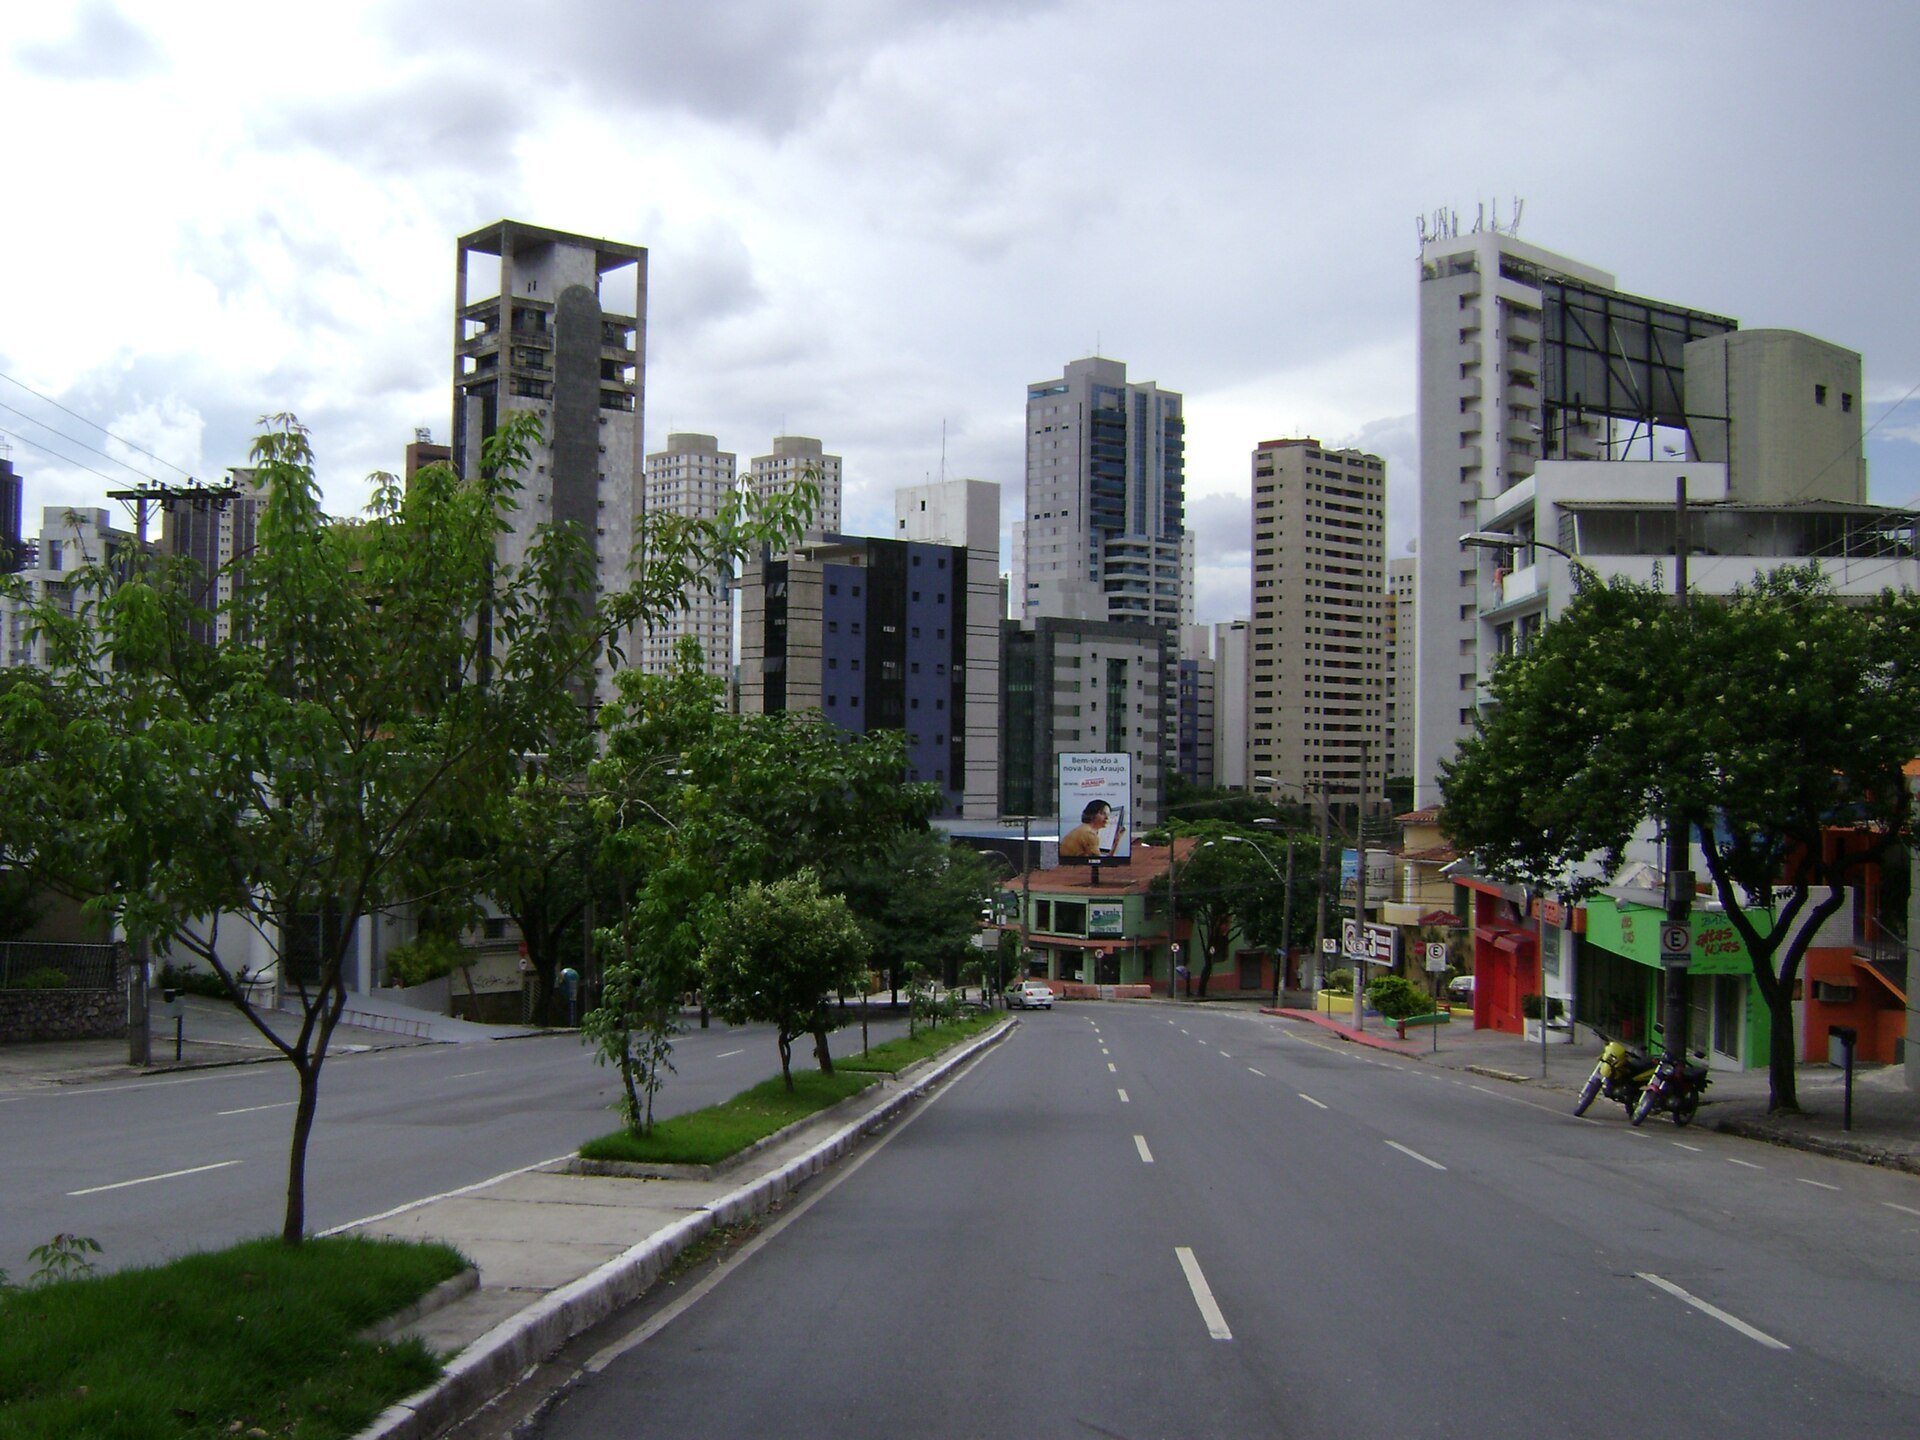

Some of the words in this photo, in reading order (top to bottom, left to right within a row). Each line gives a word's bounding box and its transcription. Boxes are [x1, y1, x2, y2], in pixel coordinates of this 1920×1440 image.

[1083, 765, 1098, 773] loja
[1099, 765, 1126, 773] Araujo.
[1081, 779, 1105, 787] ARAUJO
[1670, 931, 1681, 947] E
[1354, 943, 1361, 951] E
[1433, 946, 1439, 956] E
